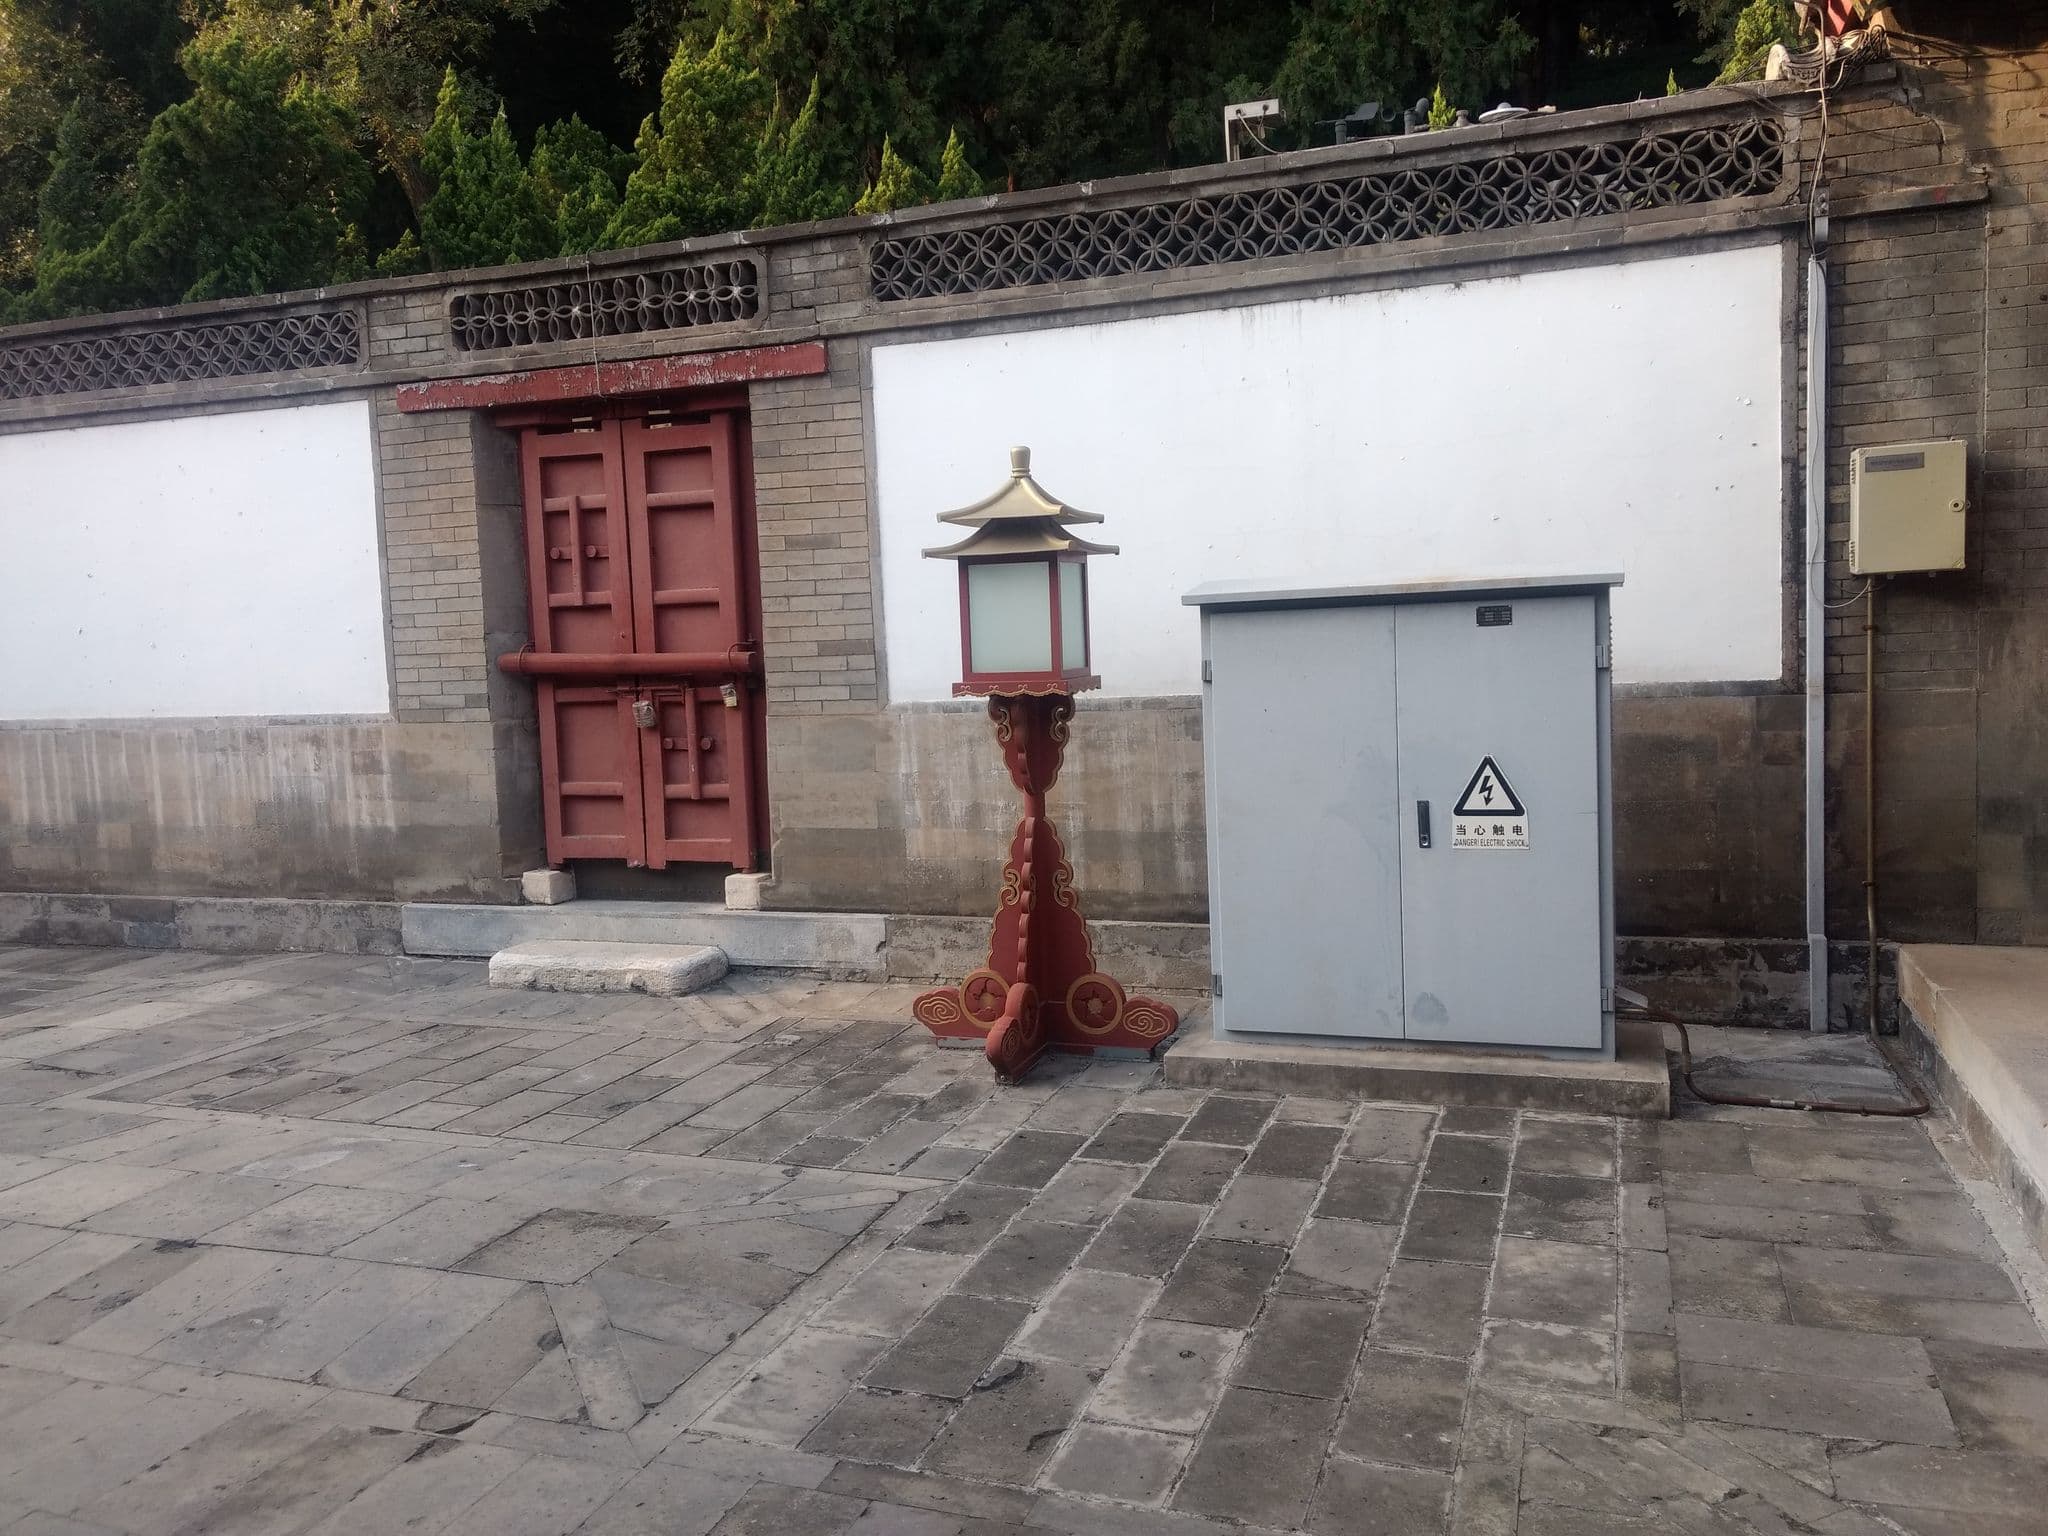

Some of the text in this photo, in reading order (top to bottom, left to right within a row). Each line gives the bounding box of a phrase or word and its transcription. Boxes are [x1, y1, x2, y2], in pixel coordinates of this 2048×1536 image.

[1456, 824, 1524, 836] 当心触电
[1480, 838, 1506, 847] ELECTRIC
[1506, 838, 1526, 848] SHOCK
